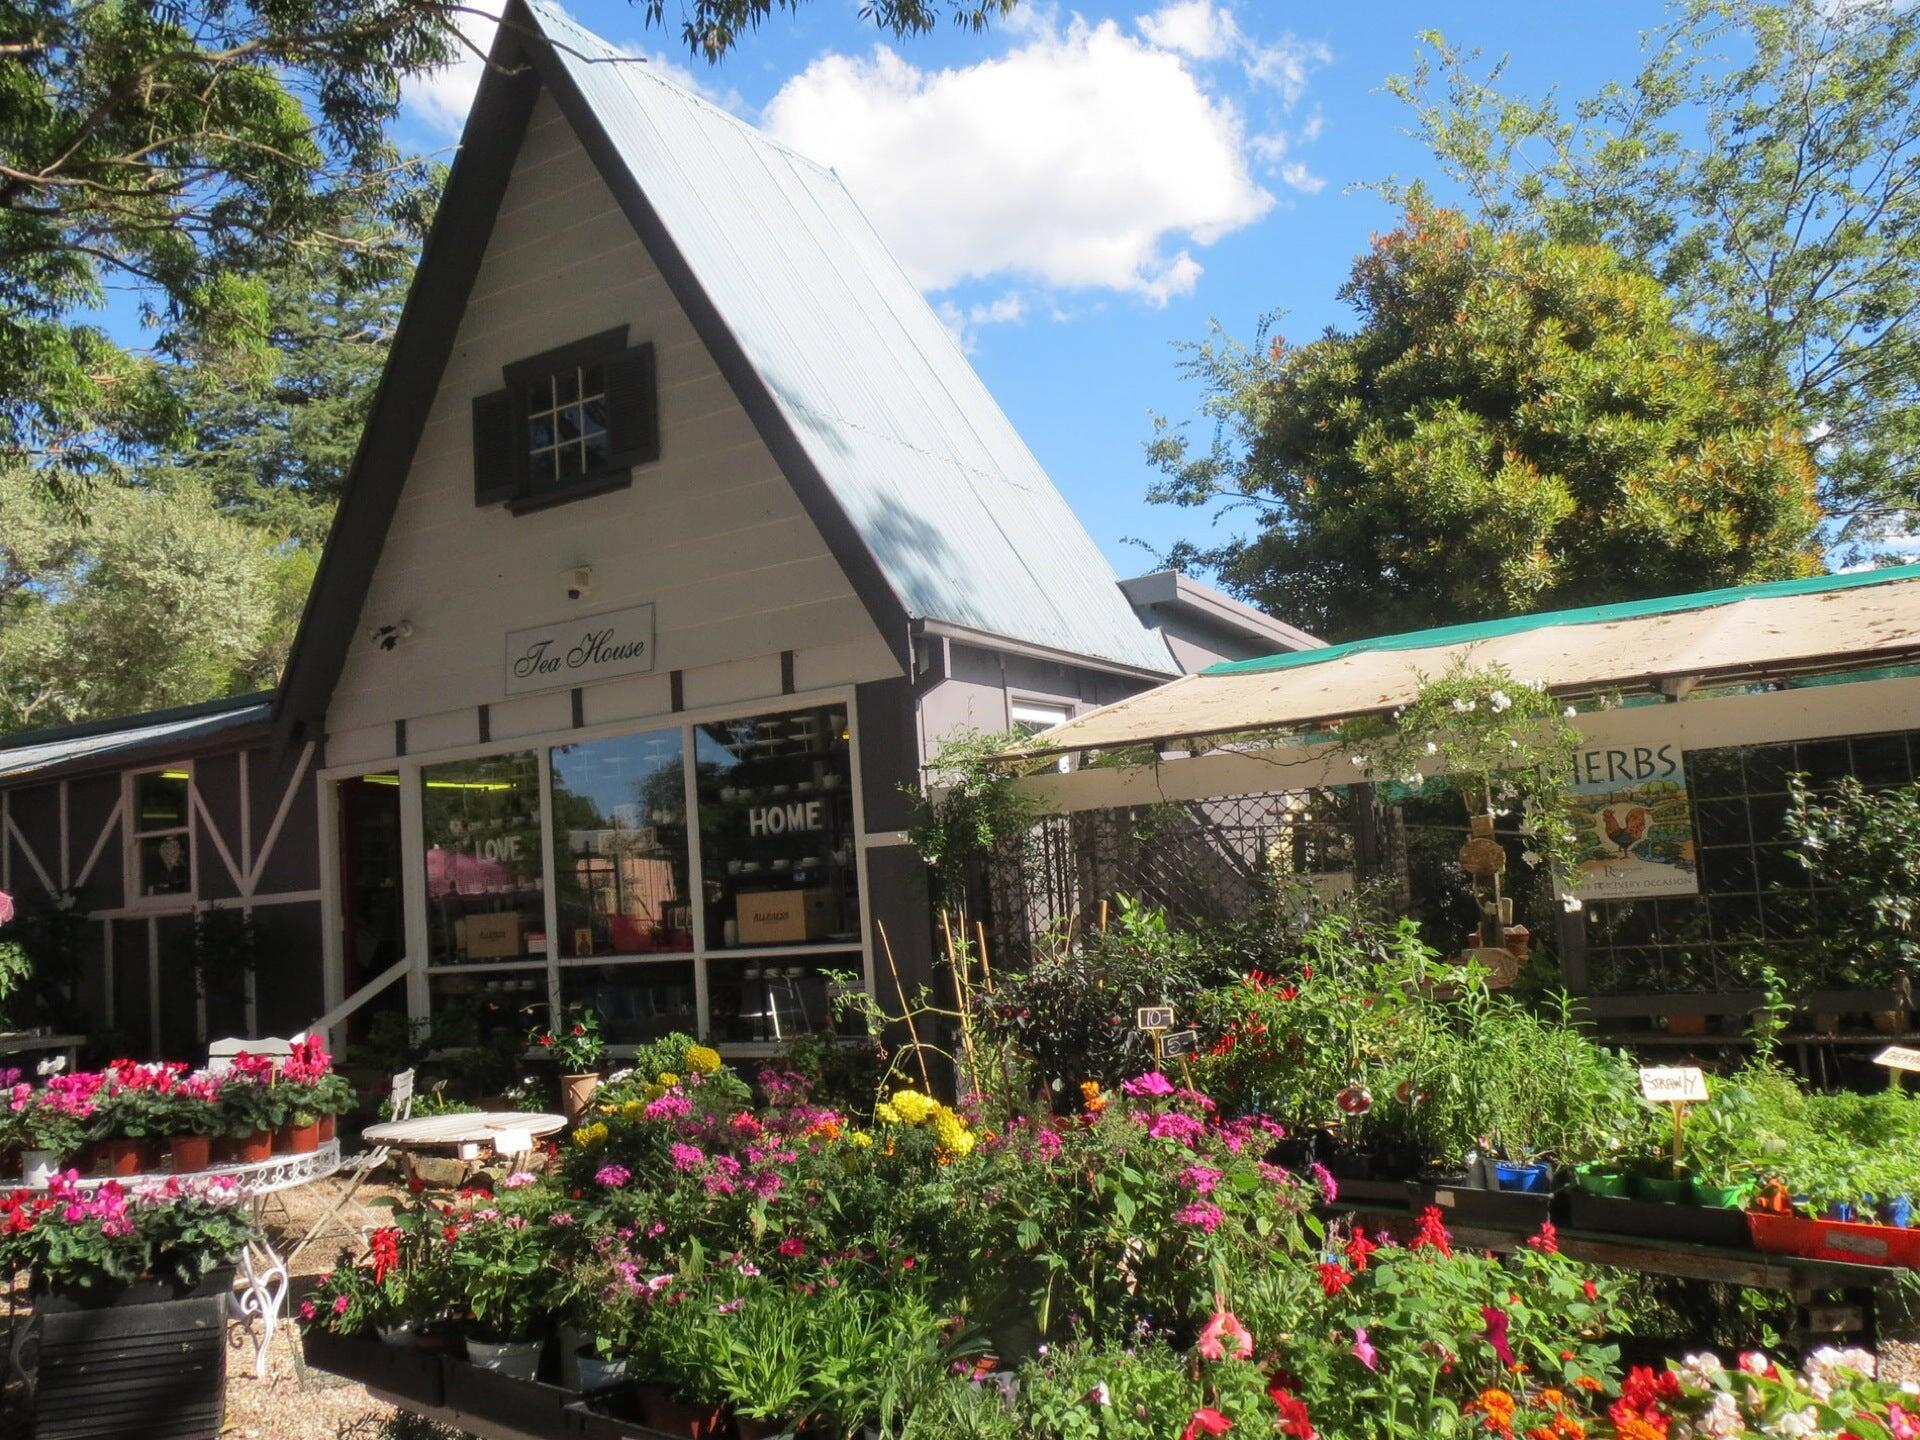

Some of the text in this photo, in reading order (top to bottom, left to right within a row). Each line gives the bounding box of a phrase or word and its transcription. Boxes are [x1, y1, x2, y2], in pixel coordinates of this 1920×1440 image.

[513, 628, 645, 678] Tea House
[749, 801, 823, 837] HOME
[475, 835, 526, 864] LOVE
